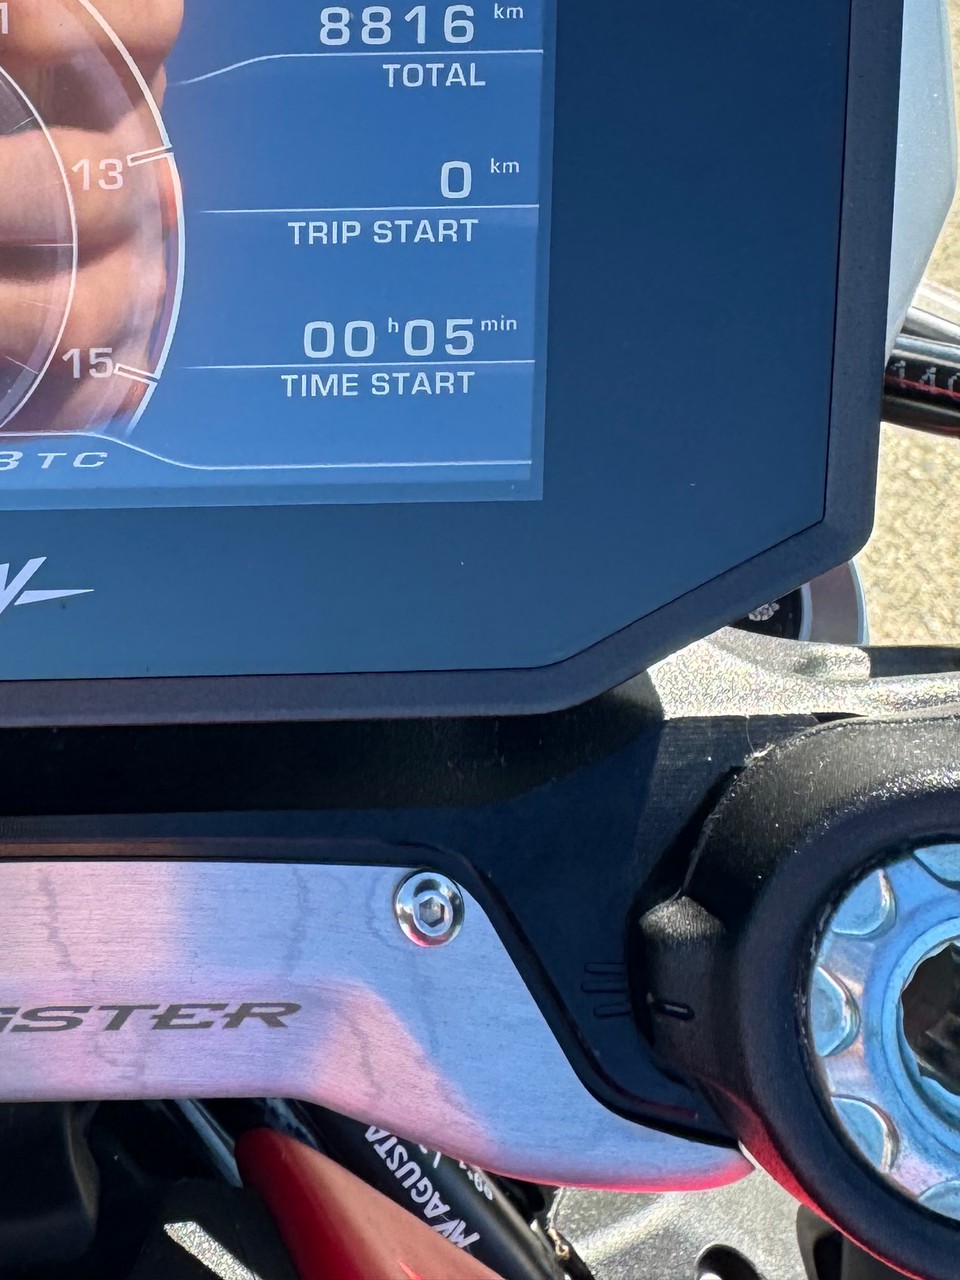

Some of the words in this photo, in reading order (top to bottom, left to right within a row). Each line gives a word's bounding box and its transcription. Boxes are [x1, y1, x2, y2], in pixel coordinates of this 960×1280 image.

[319, 4, 476, 47] 8816
[493, 2, 525, 20] km
[382, 62, 487, 88] TOTAL
[70, 158, 124, 191] 13
[439, 159, 473, 200] 0
[489, 158, 521, 175] km
[287, 219, 362, 246] TRIP
[372, 218, 480, 244] START
[480, 315, 518, 332] min
[61, 346, 115, 379] 15
[280, 373, 360, 398] TIME
[371, 371, 476, 396] START
[38, 451, 109, 471] TC
